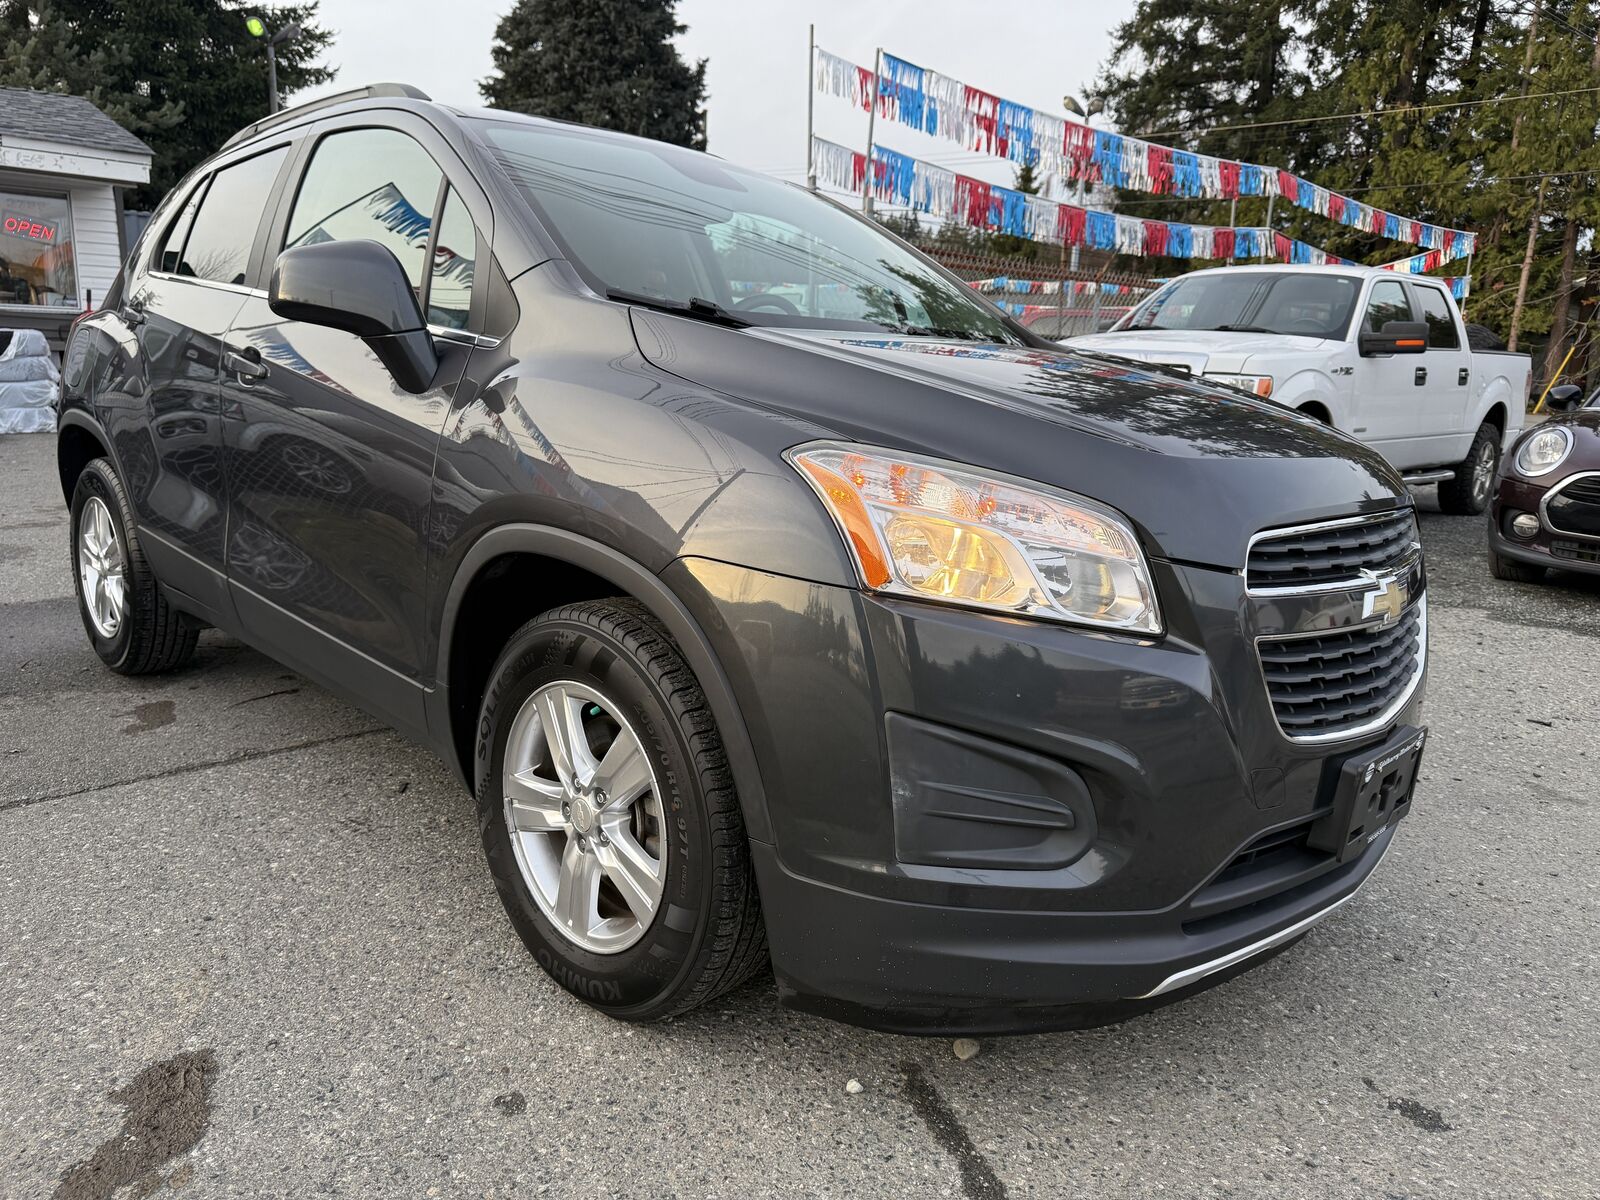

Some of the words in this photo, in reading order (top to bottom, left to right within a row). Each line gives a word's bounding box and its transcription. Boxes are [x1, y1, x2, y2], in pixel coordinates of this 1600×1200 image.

[5, 218, 55, 240] OPEN
[478, 666, 513, 761] SOLUS
[666, 771, 684, 810] R16
[677, 817, 689, 860] 97T
[537, 948, 623, 1000] KUMHO
